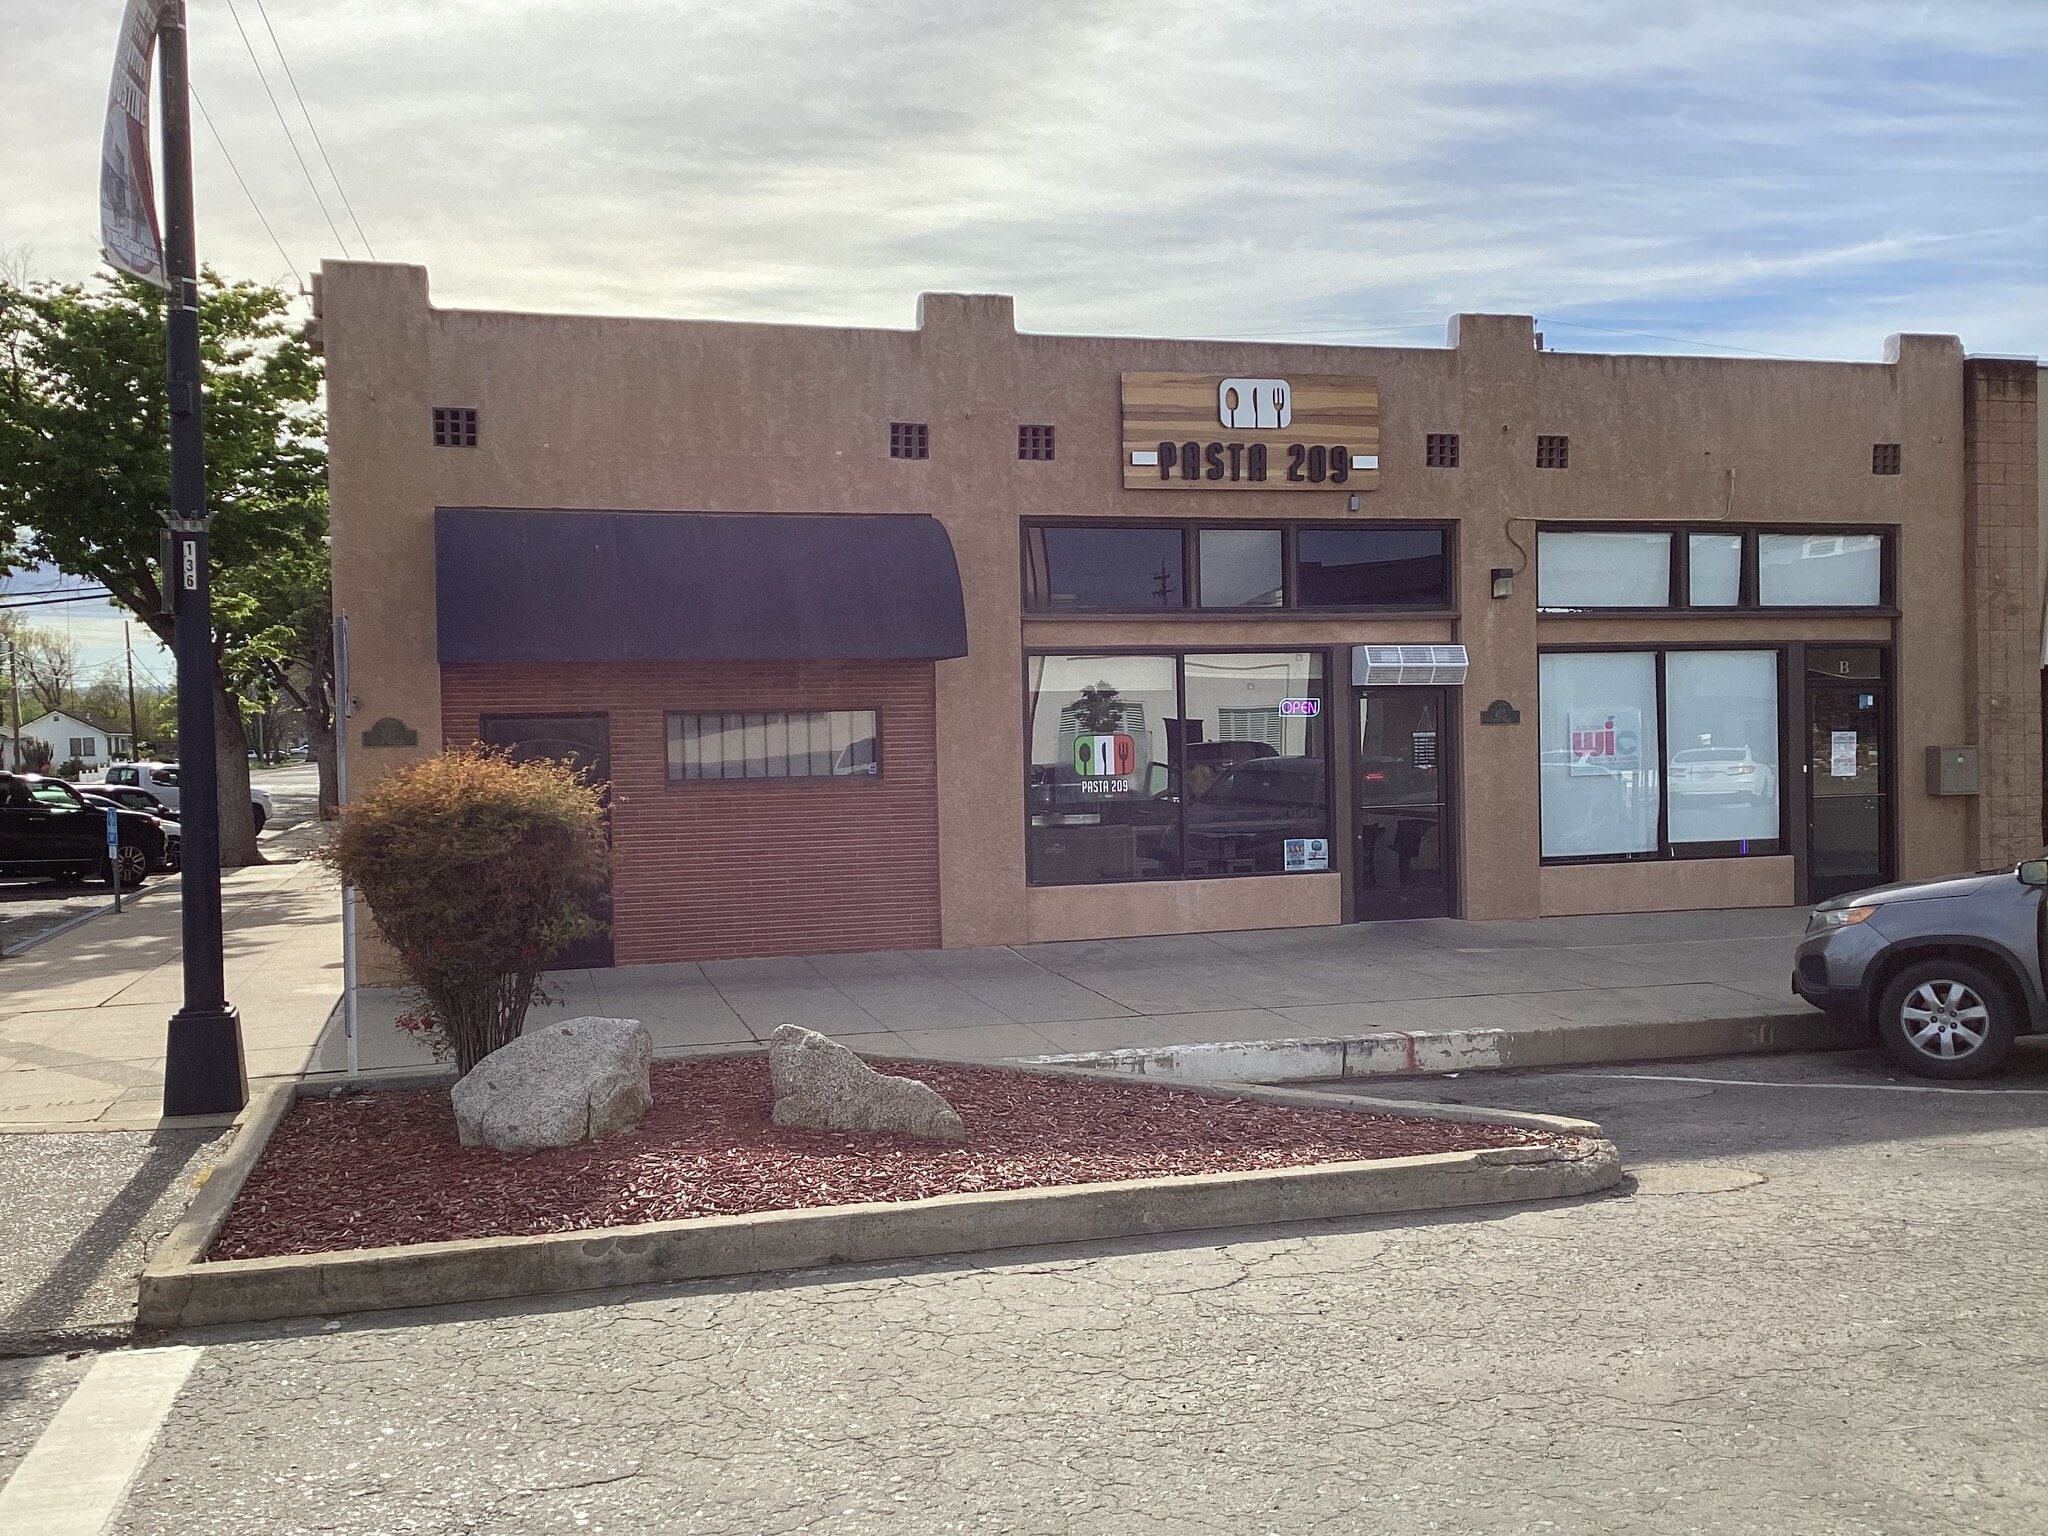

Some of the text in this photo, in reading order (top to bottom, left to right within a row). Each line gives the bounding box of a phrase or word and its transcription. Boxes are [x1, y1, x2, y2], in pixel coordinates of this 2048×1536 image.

[1158, 441, 1349, 483] PASTA 209
[186, 543, 194, 588] 136
[1840, 660, 1850, 674] B
[1281, 700, 1317, 714] OPEN
[1081, 779, 1128, 793] PASTA 209
